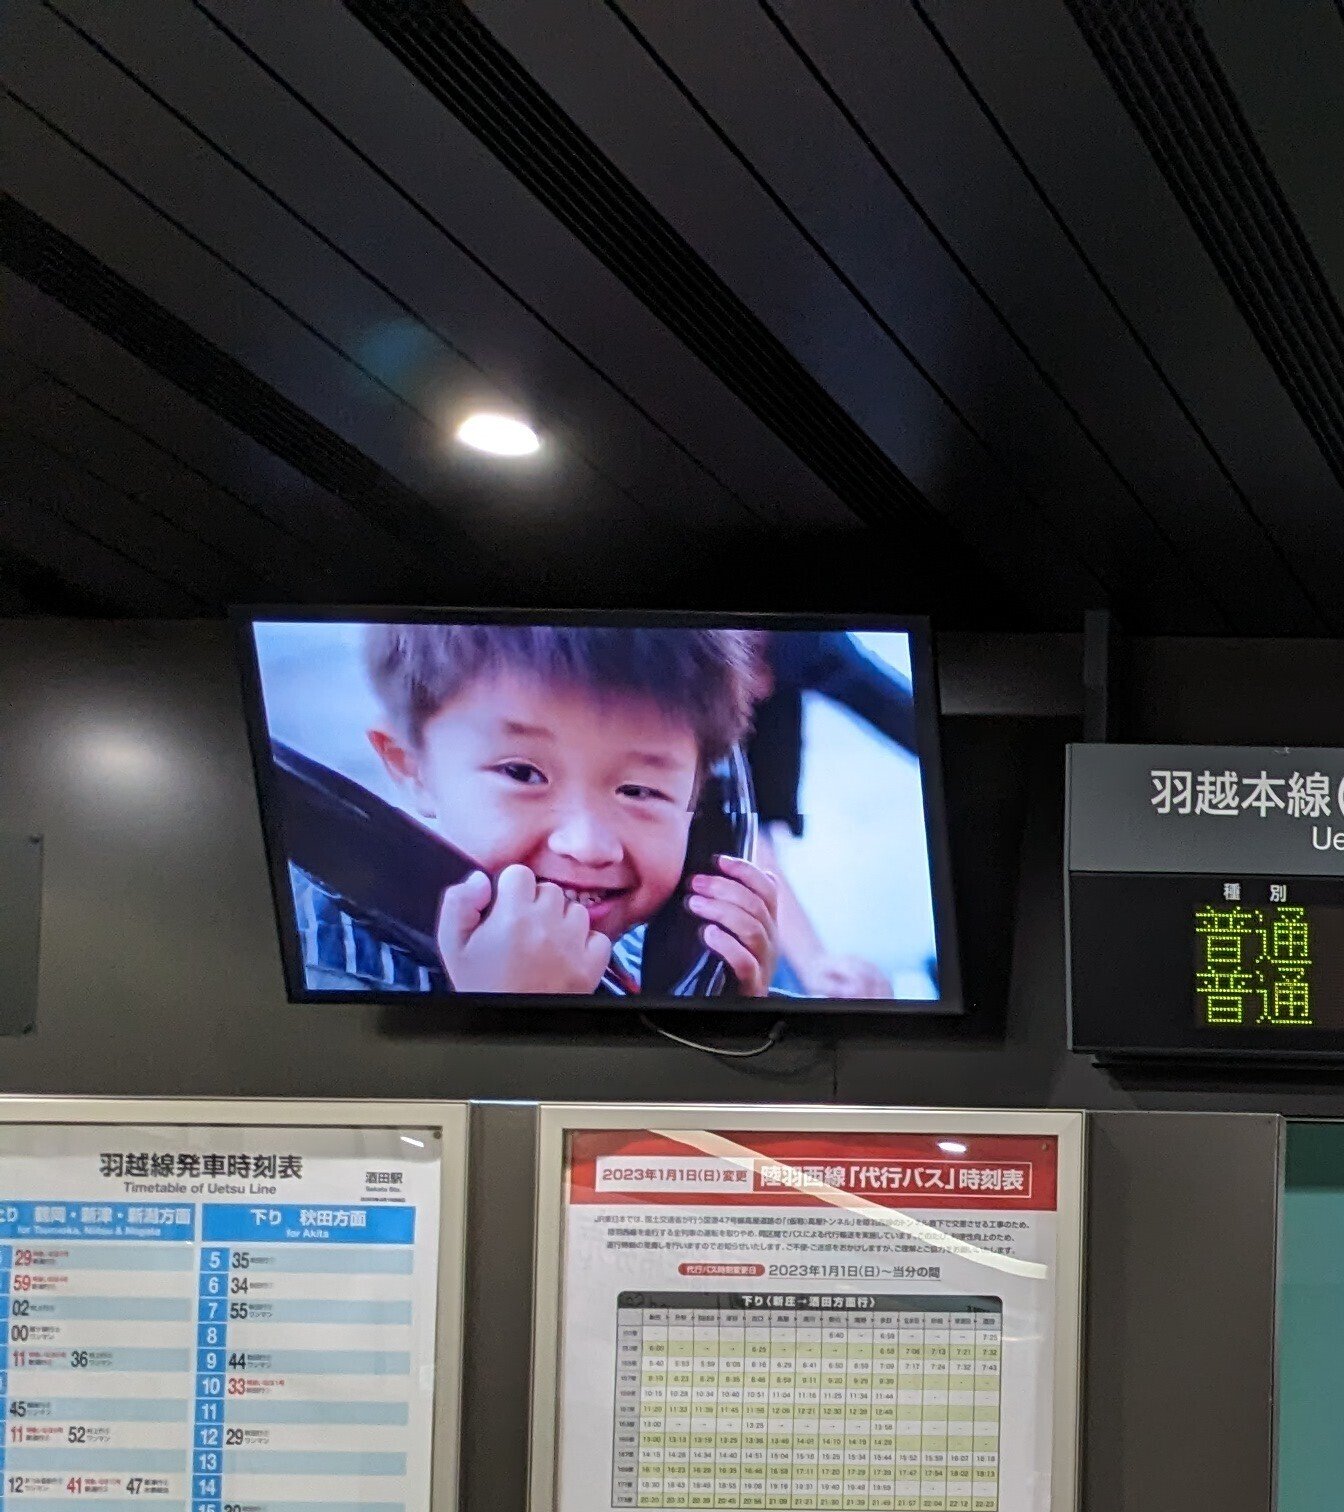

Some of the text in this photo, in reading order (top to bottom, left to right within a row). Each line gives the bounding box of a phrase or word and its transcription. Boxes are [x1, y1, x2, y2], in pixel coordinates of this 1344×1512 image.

[1196, 906, 1312, 966] 普通
[1196, 966, 1312, 1026] 普通
[100, 1154, 302, 1179] 羽越線発車時刻表
[603, 1168, 747, 1183] 2023年1月1日(日)変更
[124, 1182, 276, 1195] Timetable of Uetsu Line
[250, 1210, 366, 1226] 下り 秋田方面
[232, 1252, 249, 1268] 35
[231, 1277, 248, 1293] 34
[228, 1377, 245, 1394] 33
